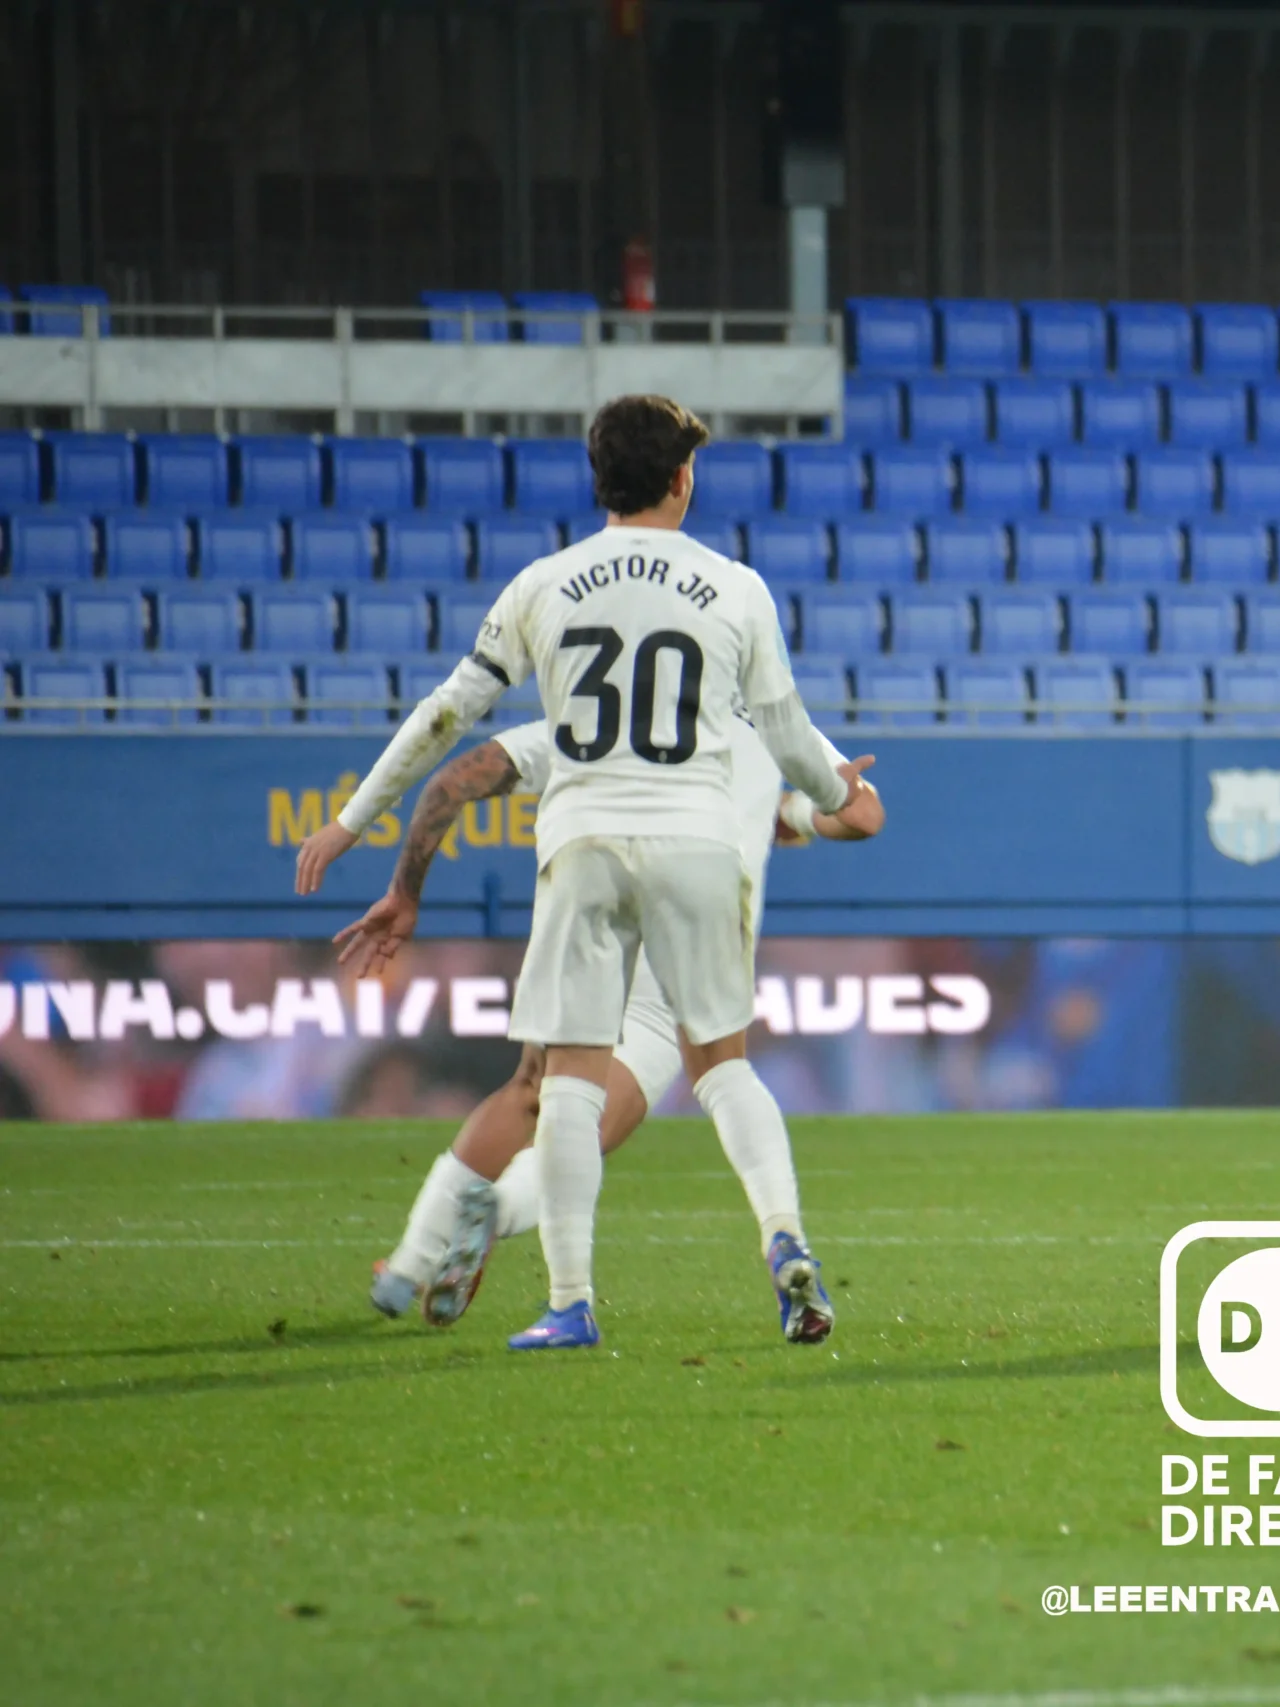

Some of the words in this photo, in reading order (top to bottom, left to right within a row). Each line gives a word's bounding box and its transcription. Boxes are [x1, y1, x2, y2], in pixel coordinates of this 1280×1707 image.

[560, 554, 670, 603] VICTOR
[677, 573, 718, 610] JR
[554, 626, 702, 764] 30
